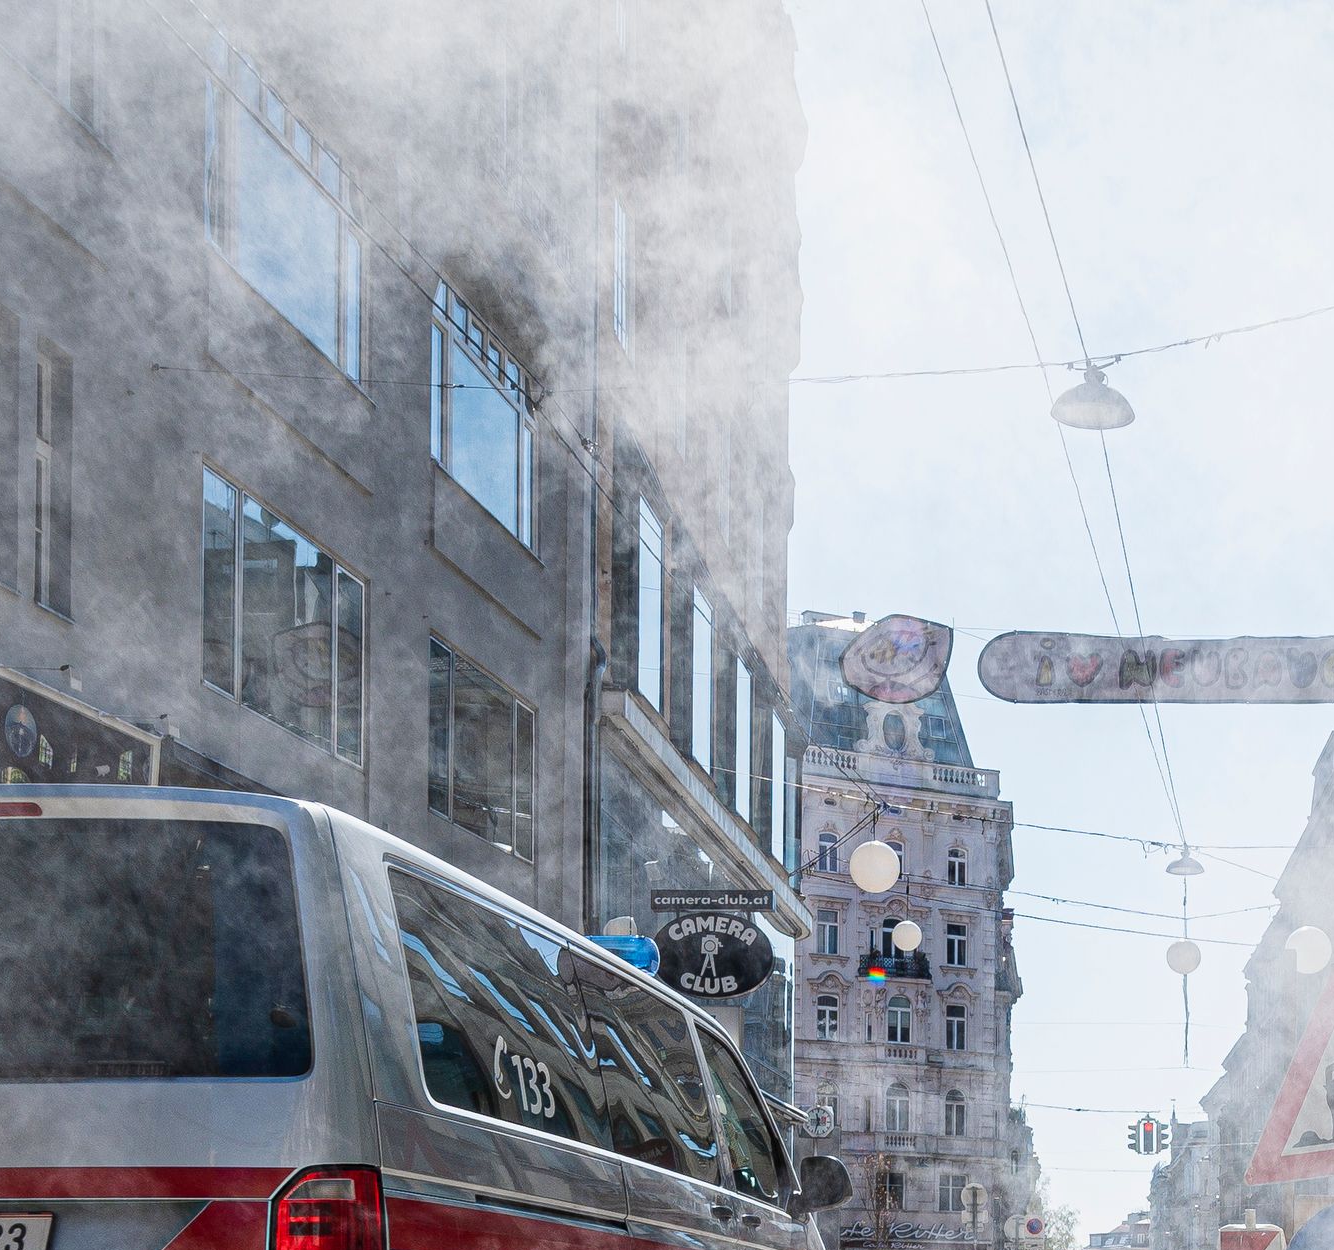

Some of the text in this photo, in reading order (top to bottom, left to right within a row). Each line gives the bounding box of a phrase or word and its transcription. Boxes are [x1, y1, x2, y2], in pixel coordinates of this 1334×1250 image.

[654, 894, 769, 906] camera-club.at
[668, 915, 758, 947] CAMERA
[680, 972, 739, 995] CLUB
[511, 1053, 556, 1119] 133
